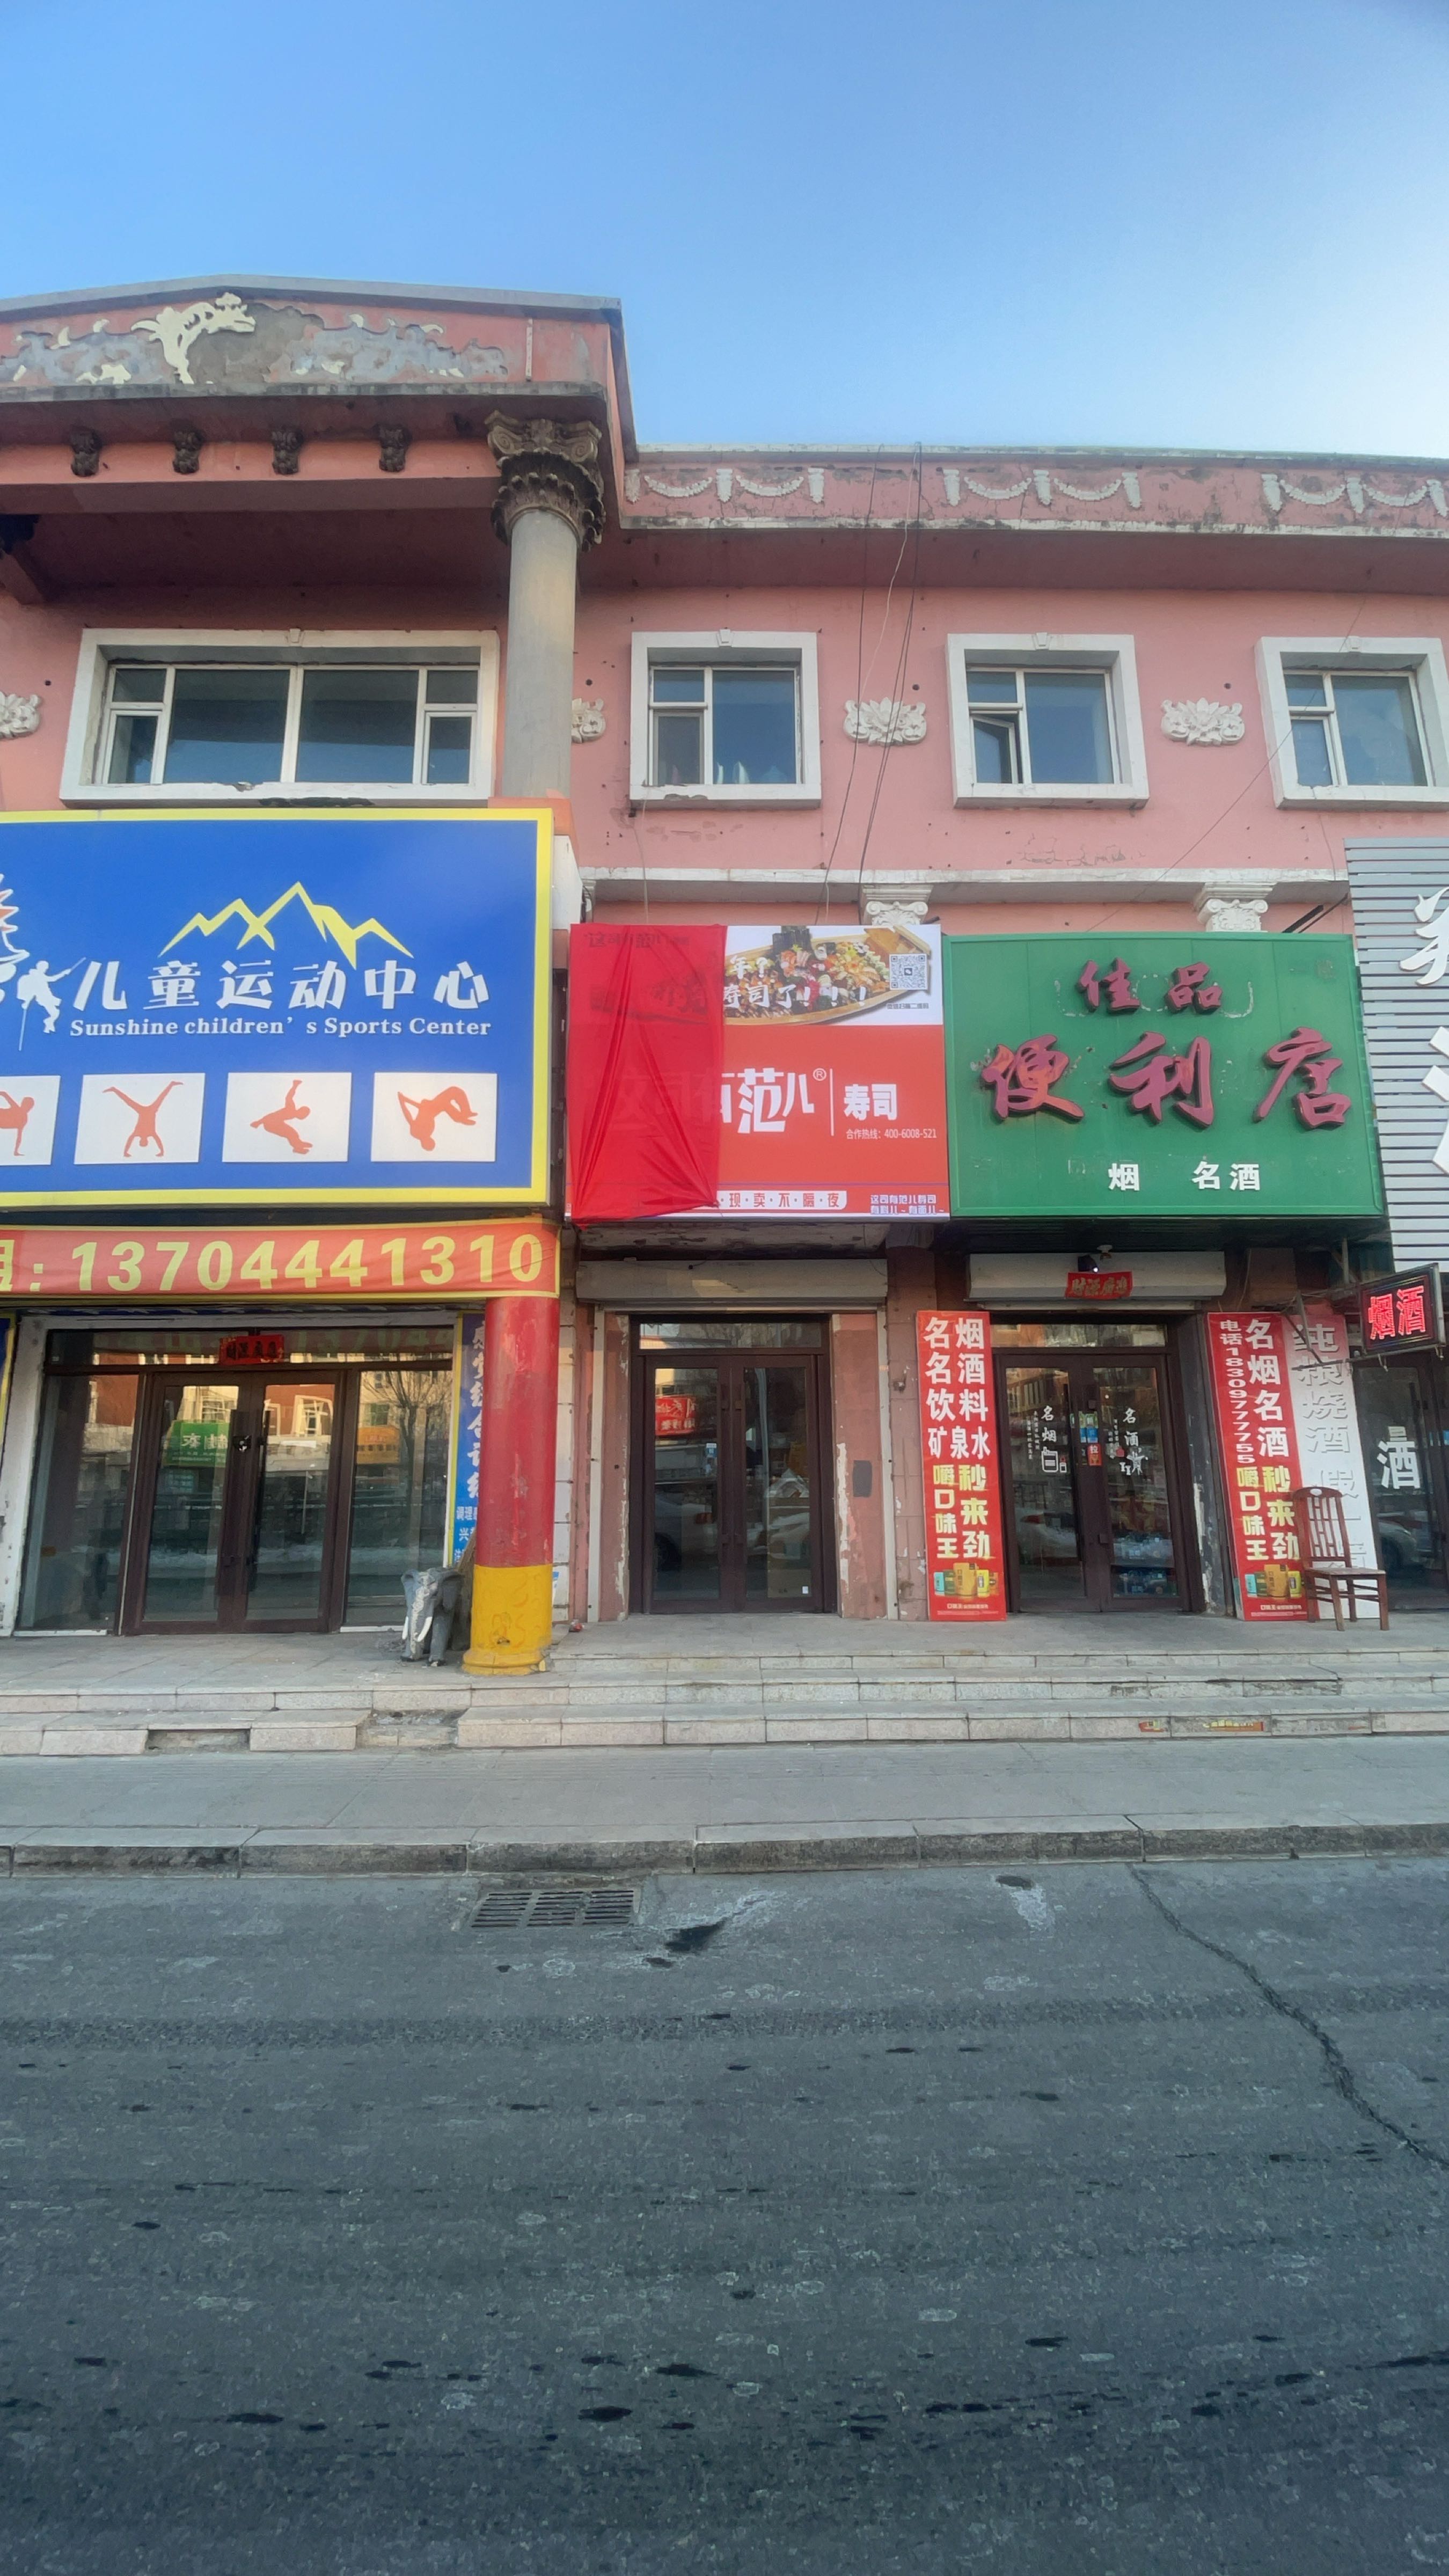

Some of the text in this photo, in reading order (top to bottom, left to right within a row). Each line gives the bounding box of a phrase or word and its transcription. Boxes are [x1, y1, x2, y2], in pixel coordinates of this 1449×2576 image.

[73, 960, 489, 1010] 儿童运动中心
[1079, 958, 1222, 1013] 佳品
[70, 1018, 178, 1037] Sunshine
[325, 1018, 402, 1038] Sports
[409, 1017, 491, 1036] Center
[982, 1027, 1352, 1130] 便利店
[844, 1084, 898, 1121] 寿司
[1108, 1161, 1261, 1192] 烟 名酒
[924, 1318, 984, 1349] 名烟
[1367, 1285, 1425, 1340] 烟酒
[925, 1352, 985, 1385] 名酒
[1245, 1319, 1289, 1458] 名烟名酒
[926, 1388, 988, 1422] 饮料
[1219, 1319, 1255, 1464] 电话18309777755
[928, 1425, 991, 1459] 矿泉水
[1041, 1405, 1057, 1443] 名烟
[1123, 1408, 1139, 1447] 名酒
[1377, 1440, 1421, 1490] 酒
[958, 1464, 991, 1558] 秒来劲
[1262, 1465, 1300, 1561] 秒来劲
